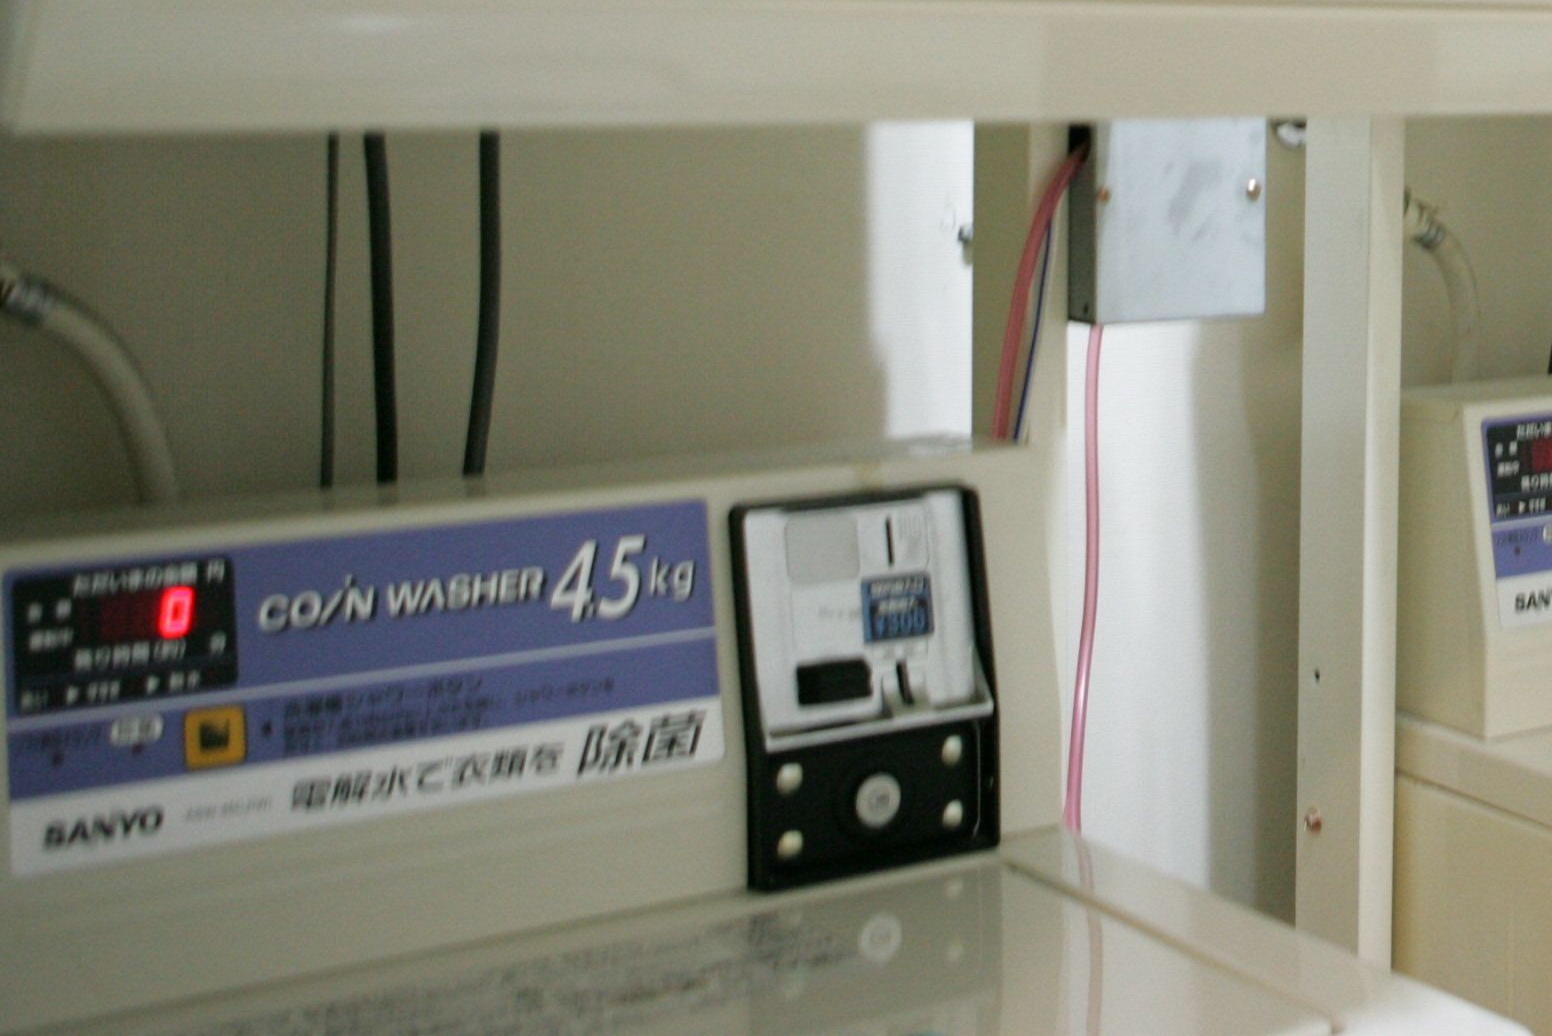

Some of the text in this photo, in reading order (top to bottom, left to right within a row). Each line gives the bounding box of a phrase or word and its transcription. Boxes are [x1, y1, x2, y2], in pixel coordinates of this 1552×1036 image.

[159, 585, 196, 640] 0
[386, 566, 546, 619] WASHER
[44, 807, 164, 850] SANYO
